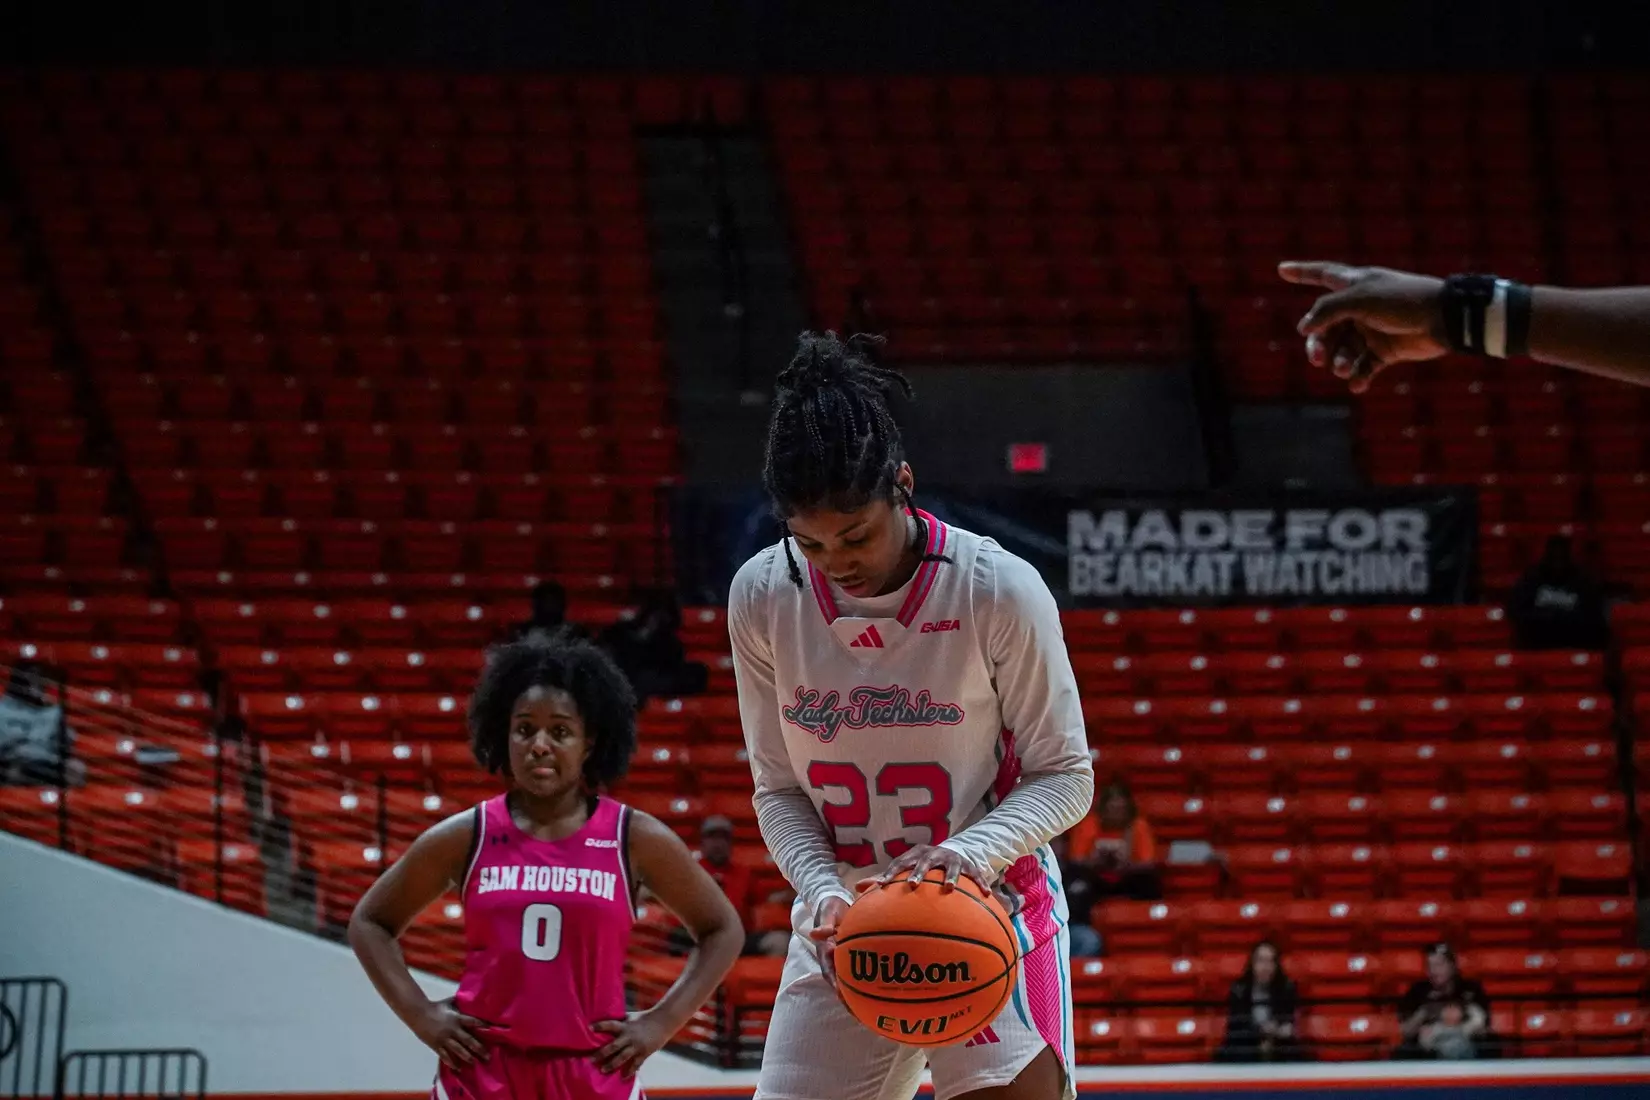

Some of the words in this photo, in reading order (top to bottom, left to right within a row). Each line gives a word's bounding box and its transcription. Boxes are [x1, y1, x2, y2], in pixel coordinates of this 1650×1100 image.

[1067, 509, 1276, 550] MADE
[1285, 508, 1430, 550] FOR
[1068, 550, 1236, 596] BEARKAT
[1241, 549, 1430, 596] WATCHING
[782, 685, 844, 743] Lady
[843, 684, 965, 729] Techsters
[807, 760, 953, 869] 23
[478, 865, 521, 894] SAM
[521, 865, 617, 902] HOUSTON
[521, 902, 562, 962] 0
[849, 950, 970, 983] Wilson
[877, 1015, 949, 1035] EVO
